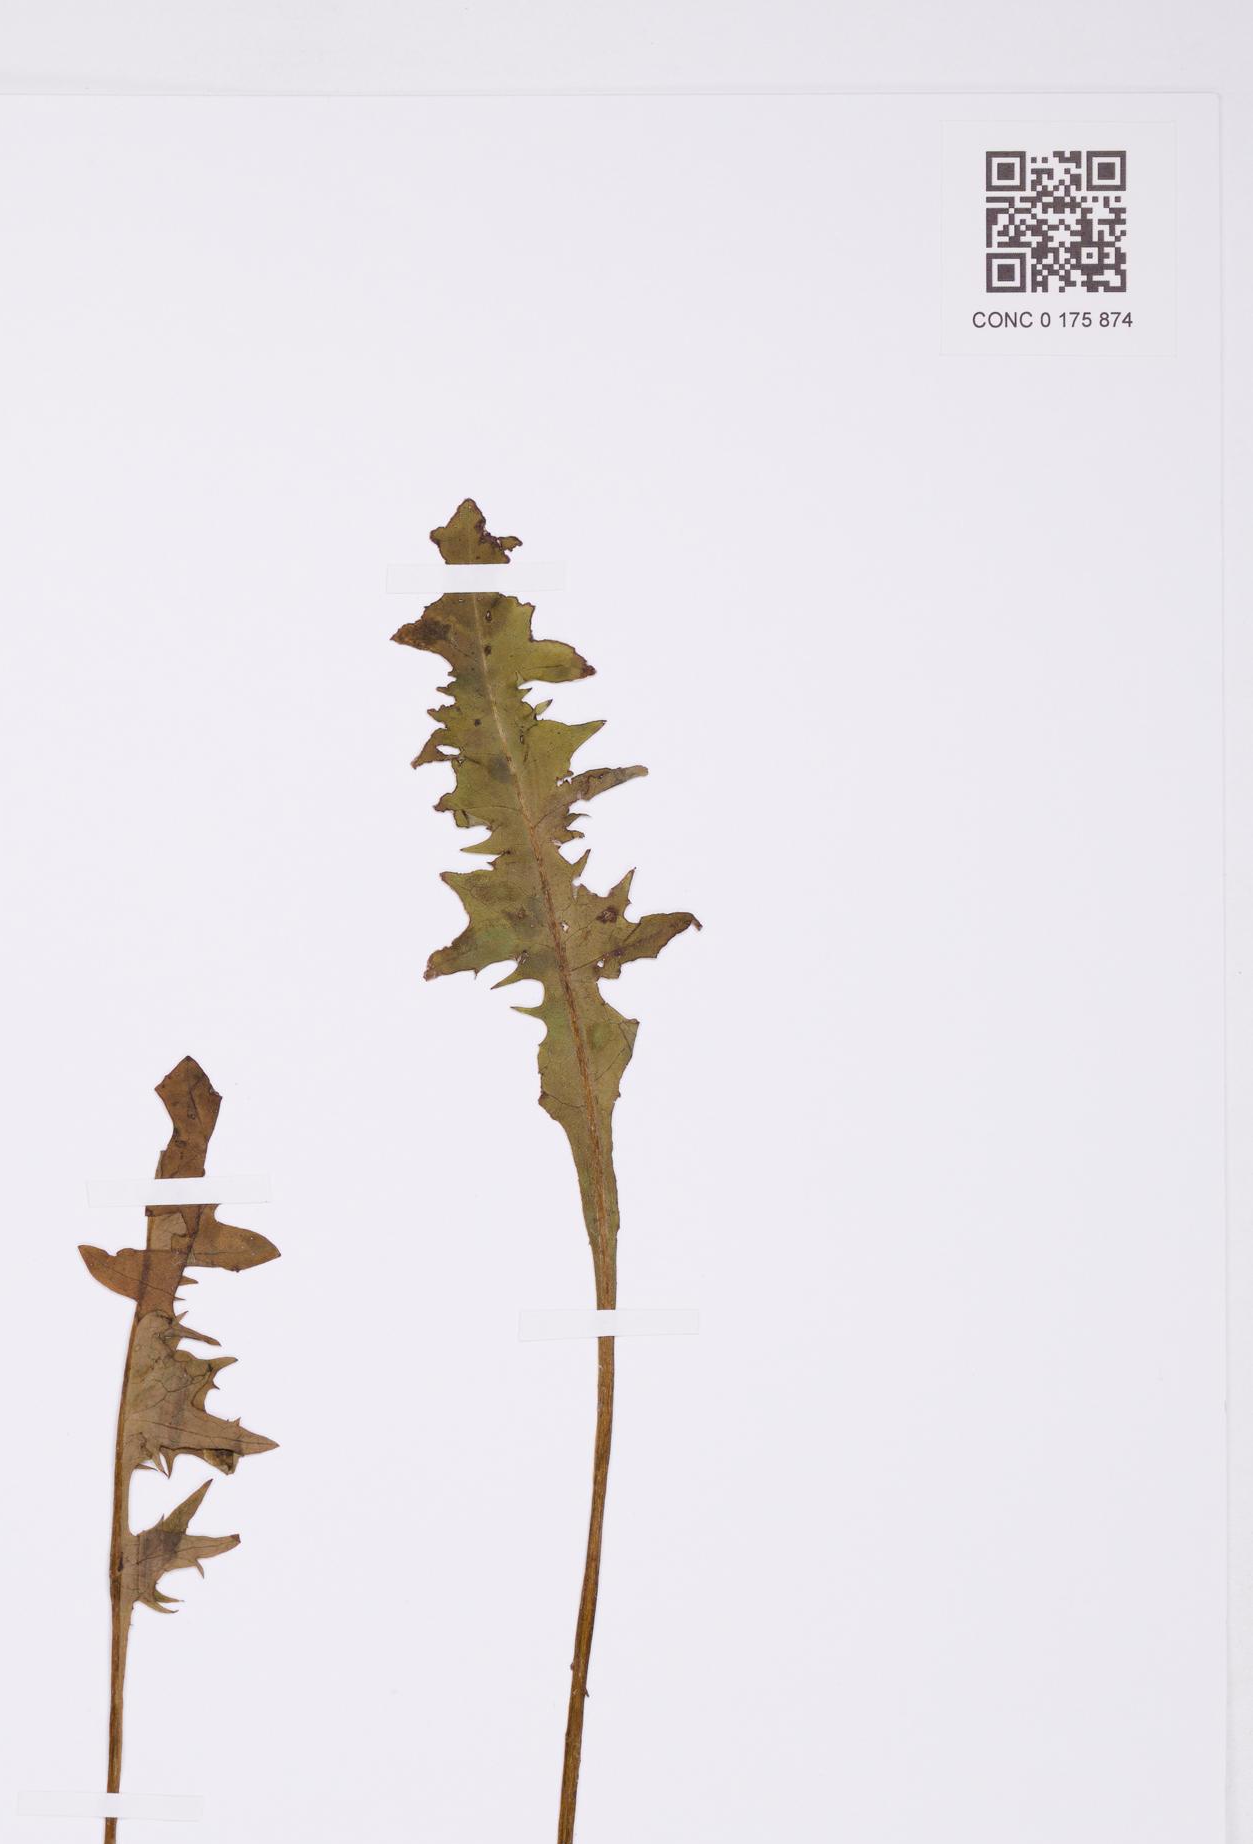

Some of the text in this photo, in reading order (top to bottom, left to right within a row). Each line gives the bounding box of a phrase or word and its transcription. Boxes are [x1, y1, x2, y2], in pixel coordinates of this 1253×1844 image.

[972, 311, 1133, 329] CONC 0 175 874
